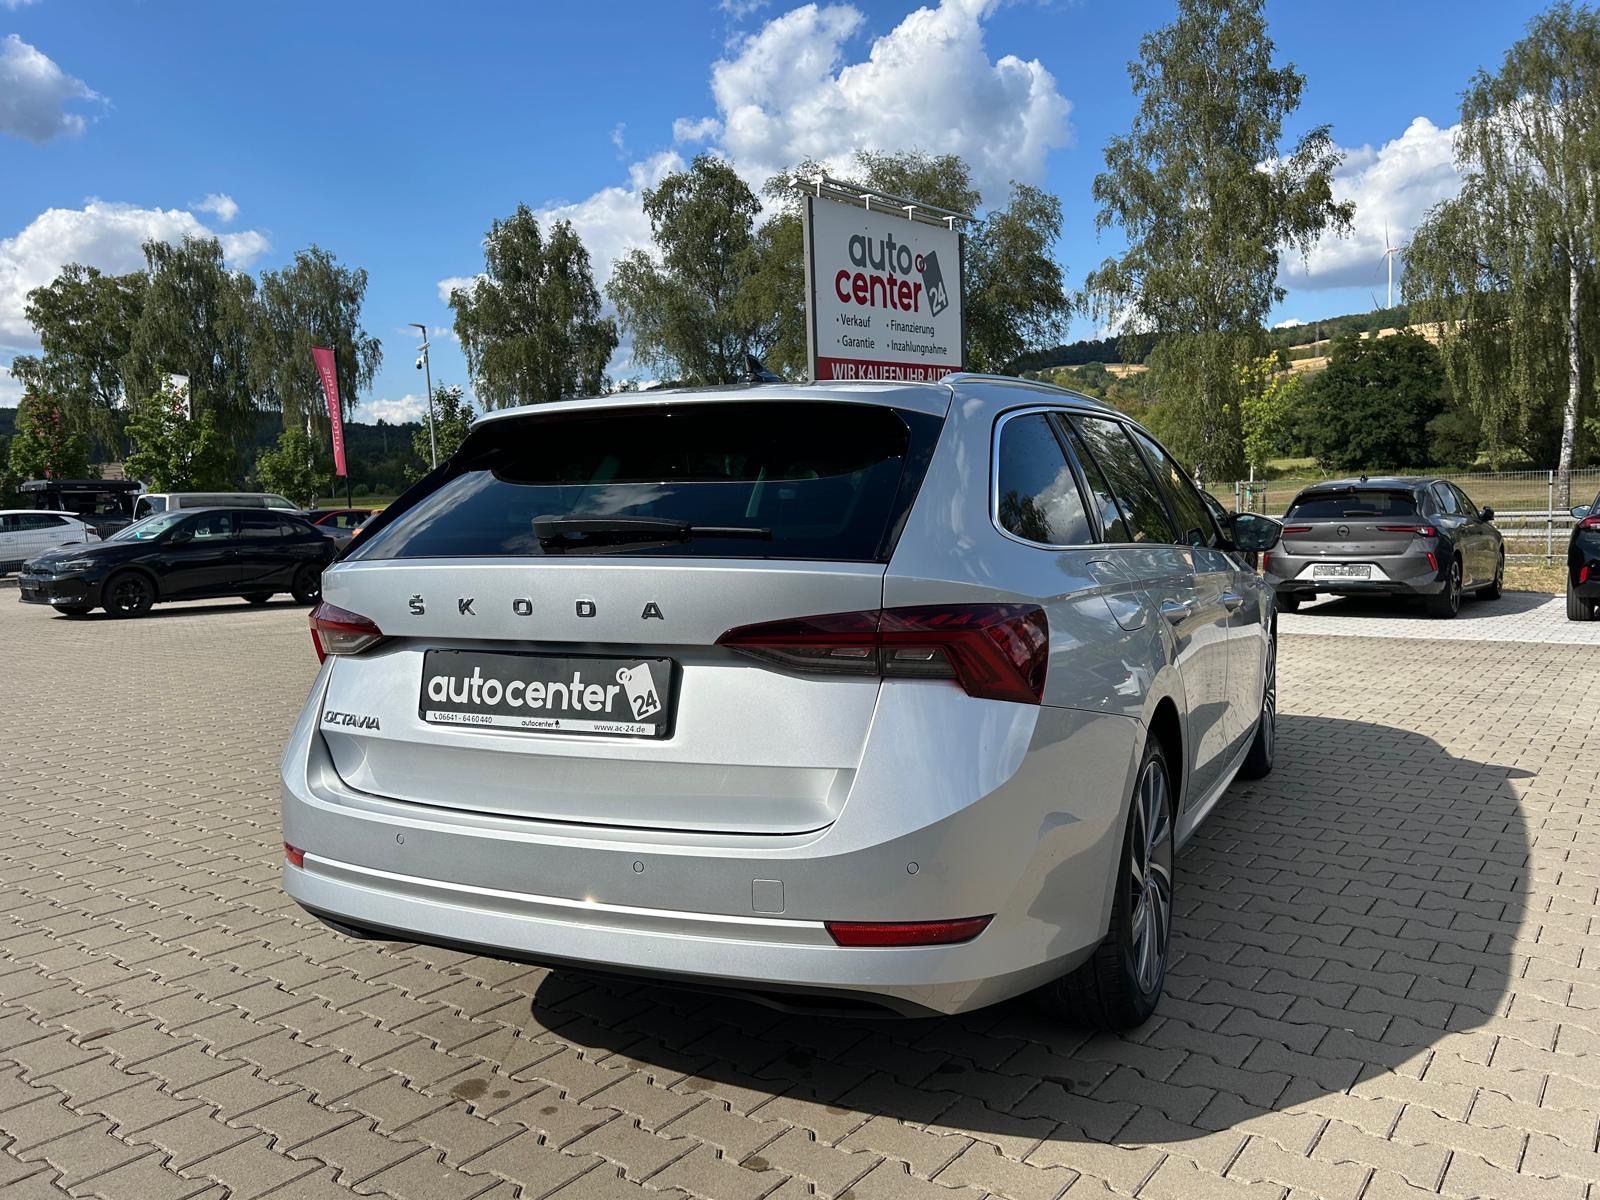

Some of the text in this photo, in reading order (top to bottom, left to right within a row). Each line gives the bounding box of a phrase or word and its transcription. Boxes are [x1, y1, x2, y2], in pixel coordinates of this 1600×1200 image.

[848, 232, 912, 275] auto
[835, 269, 922, 312] center
[929, 281, 947, 314] 24
[841, 314, 871, 328] Verkauf
[890, 320, 935, 337] Finanzierung
[842, 335, 875, 349] Garantie
[891, 340, 948, 356] Inzahlungnahme
[831, 362, 856, 380] WIR
[858, 364, 904, 381] KAUFEN
[906, 367, 925, 382] IHR
[407, 593, 665, 621] ŠKODA
[427, 666, 620, 713] autocenter
[632, 690, 658, 717] 24
[324, 710, 380, 730] OCTAVIA
[521, 719, 554, 728] autocenter
[594, 724, 646, 734] www.ac-24.de
